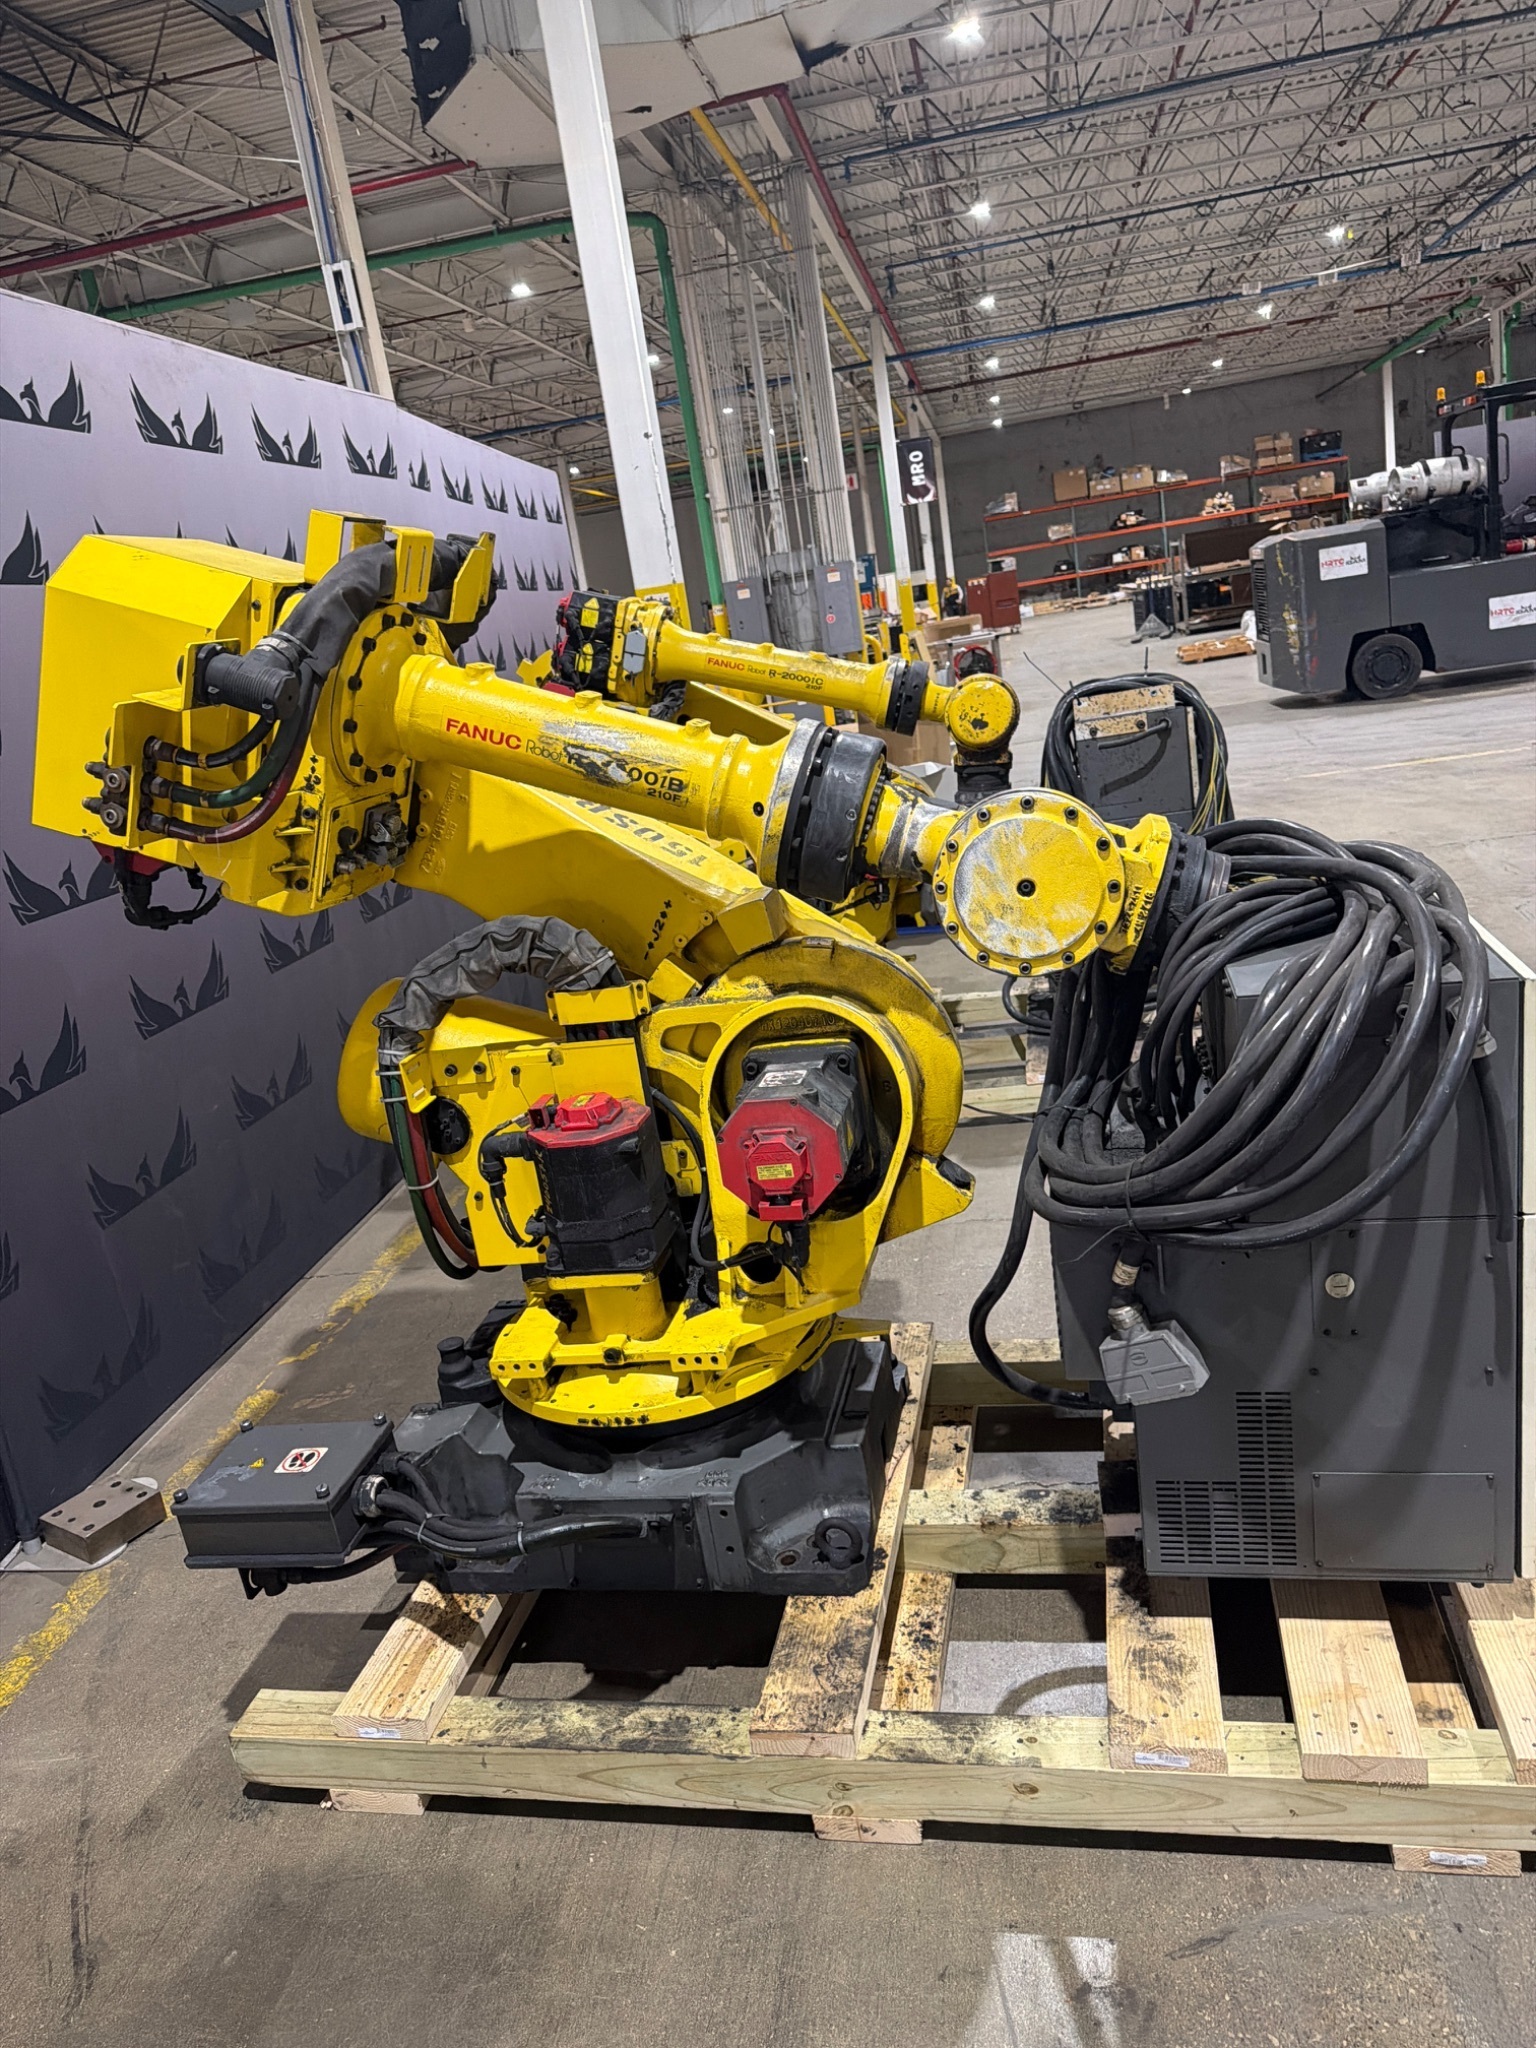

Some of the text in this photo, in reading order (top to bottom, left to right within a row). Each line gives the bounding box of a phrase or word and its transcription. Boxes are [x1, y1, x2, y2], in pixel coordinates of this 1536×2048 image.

[909, 450, 926, 486] MRO
[707, 657, 824, 686] FANUC Robot R-2000iC
[805, 683, 823, 692] 210F
[446, 717, 522, 751] FANUC
[525, 739, 564, 763] Robot
[647, 788, 682, 803] 210F
